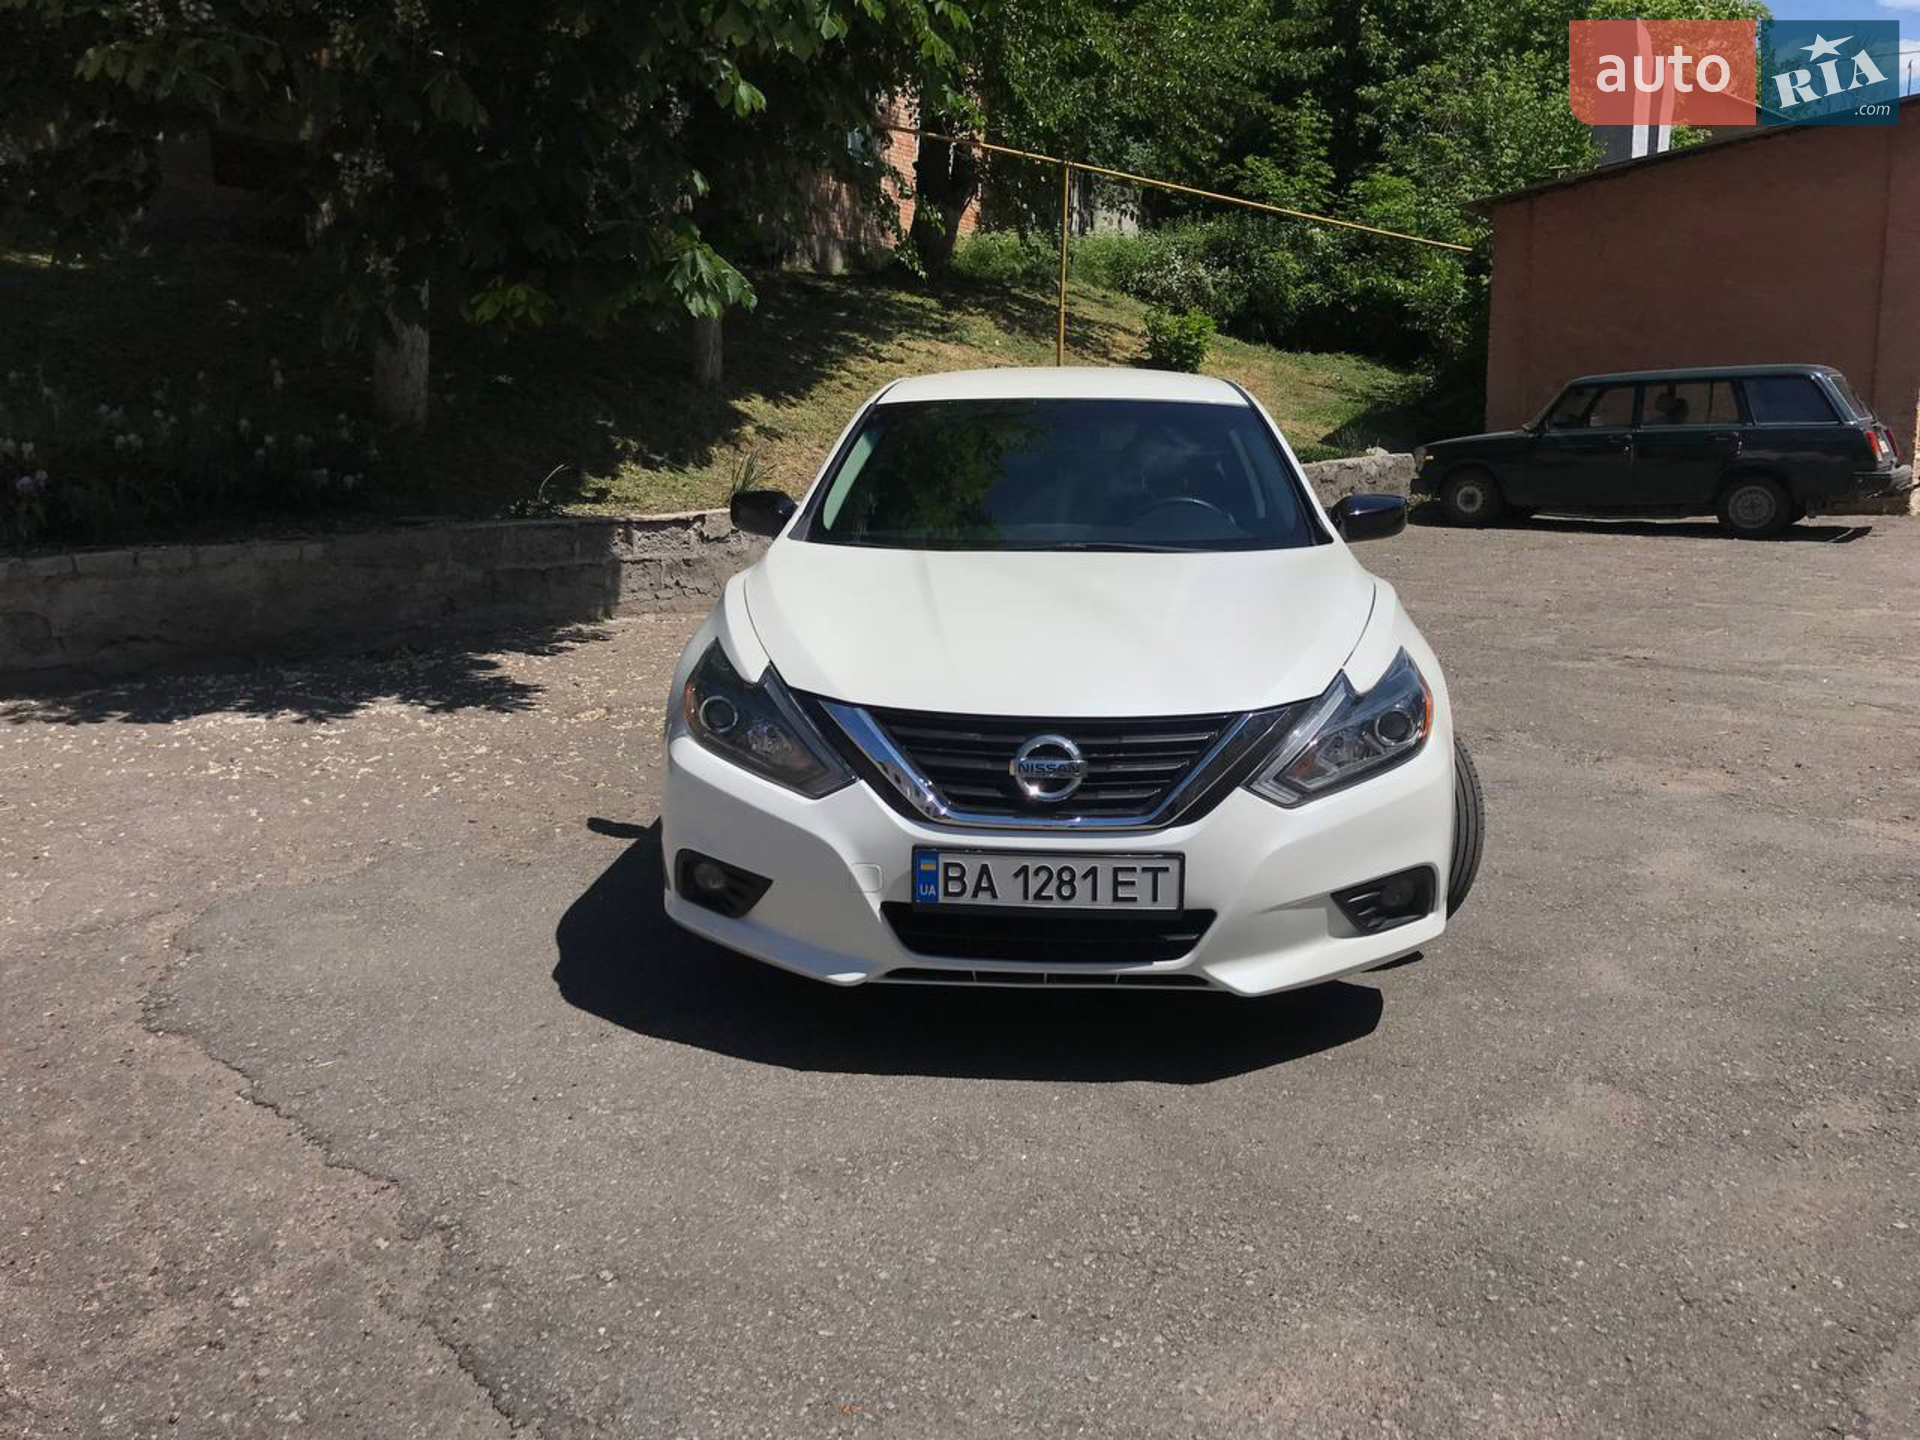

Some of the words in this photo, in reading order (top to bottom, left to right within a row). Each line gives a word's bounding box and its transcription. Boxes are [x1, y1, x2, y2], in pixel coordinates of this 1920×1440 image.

[1018, 762, 1081, 775] NISSAN
[943, 862, 998, 900] BA
[1012, 865, 1099, 902] 1281
[1112, 866, 1170, 903] ET
[920, 885, 937, 896] UA
